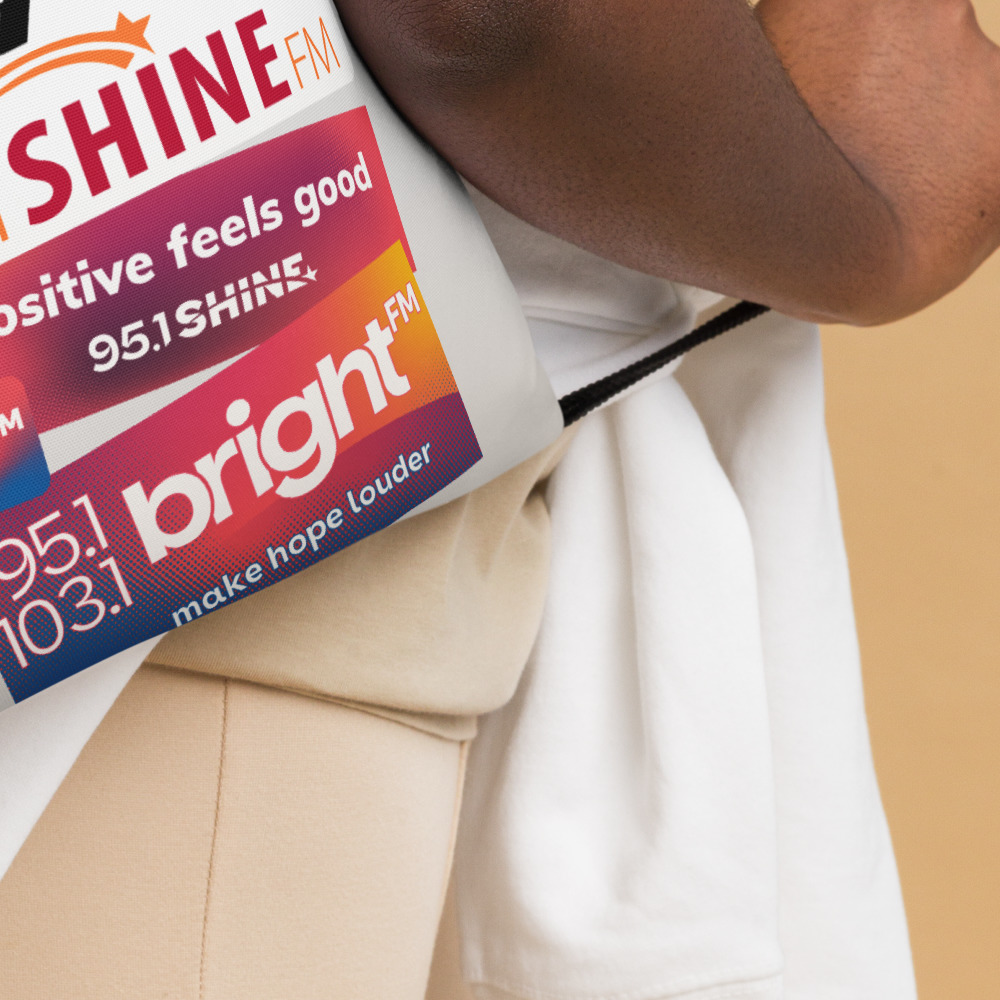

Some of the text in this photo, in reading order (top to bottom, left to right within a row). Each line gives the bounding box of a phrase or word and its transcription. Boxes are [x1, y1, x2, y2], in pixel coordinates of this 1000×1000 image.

[6, 8, 292, 226] SHINE
[284, 16, 341, 90] FM
[166, 193, 283, 269] feels
[293, 151, 373, 228] good
[87, 253, 312, 373] 95.1 SHINE
[171, 442, 432, 627] make hope louder
